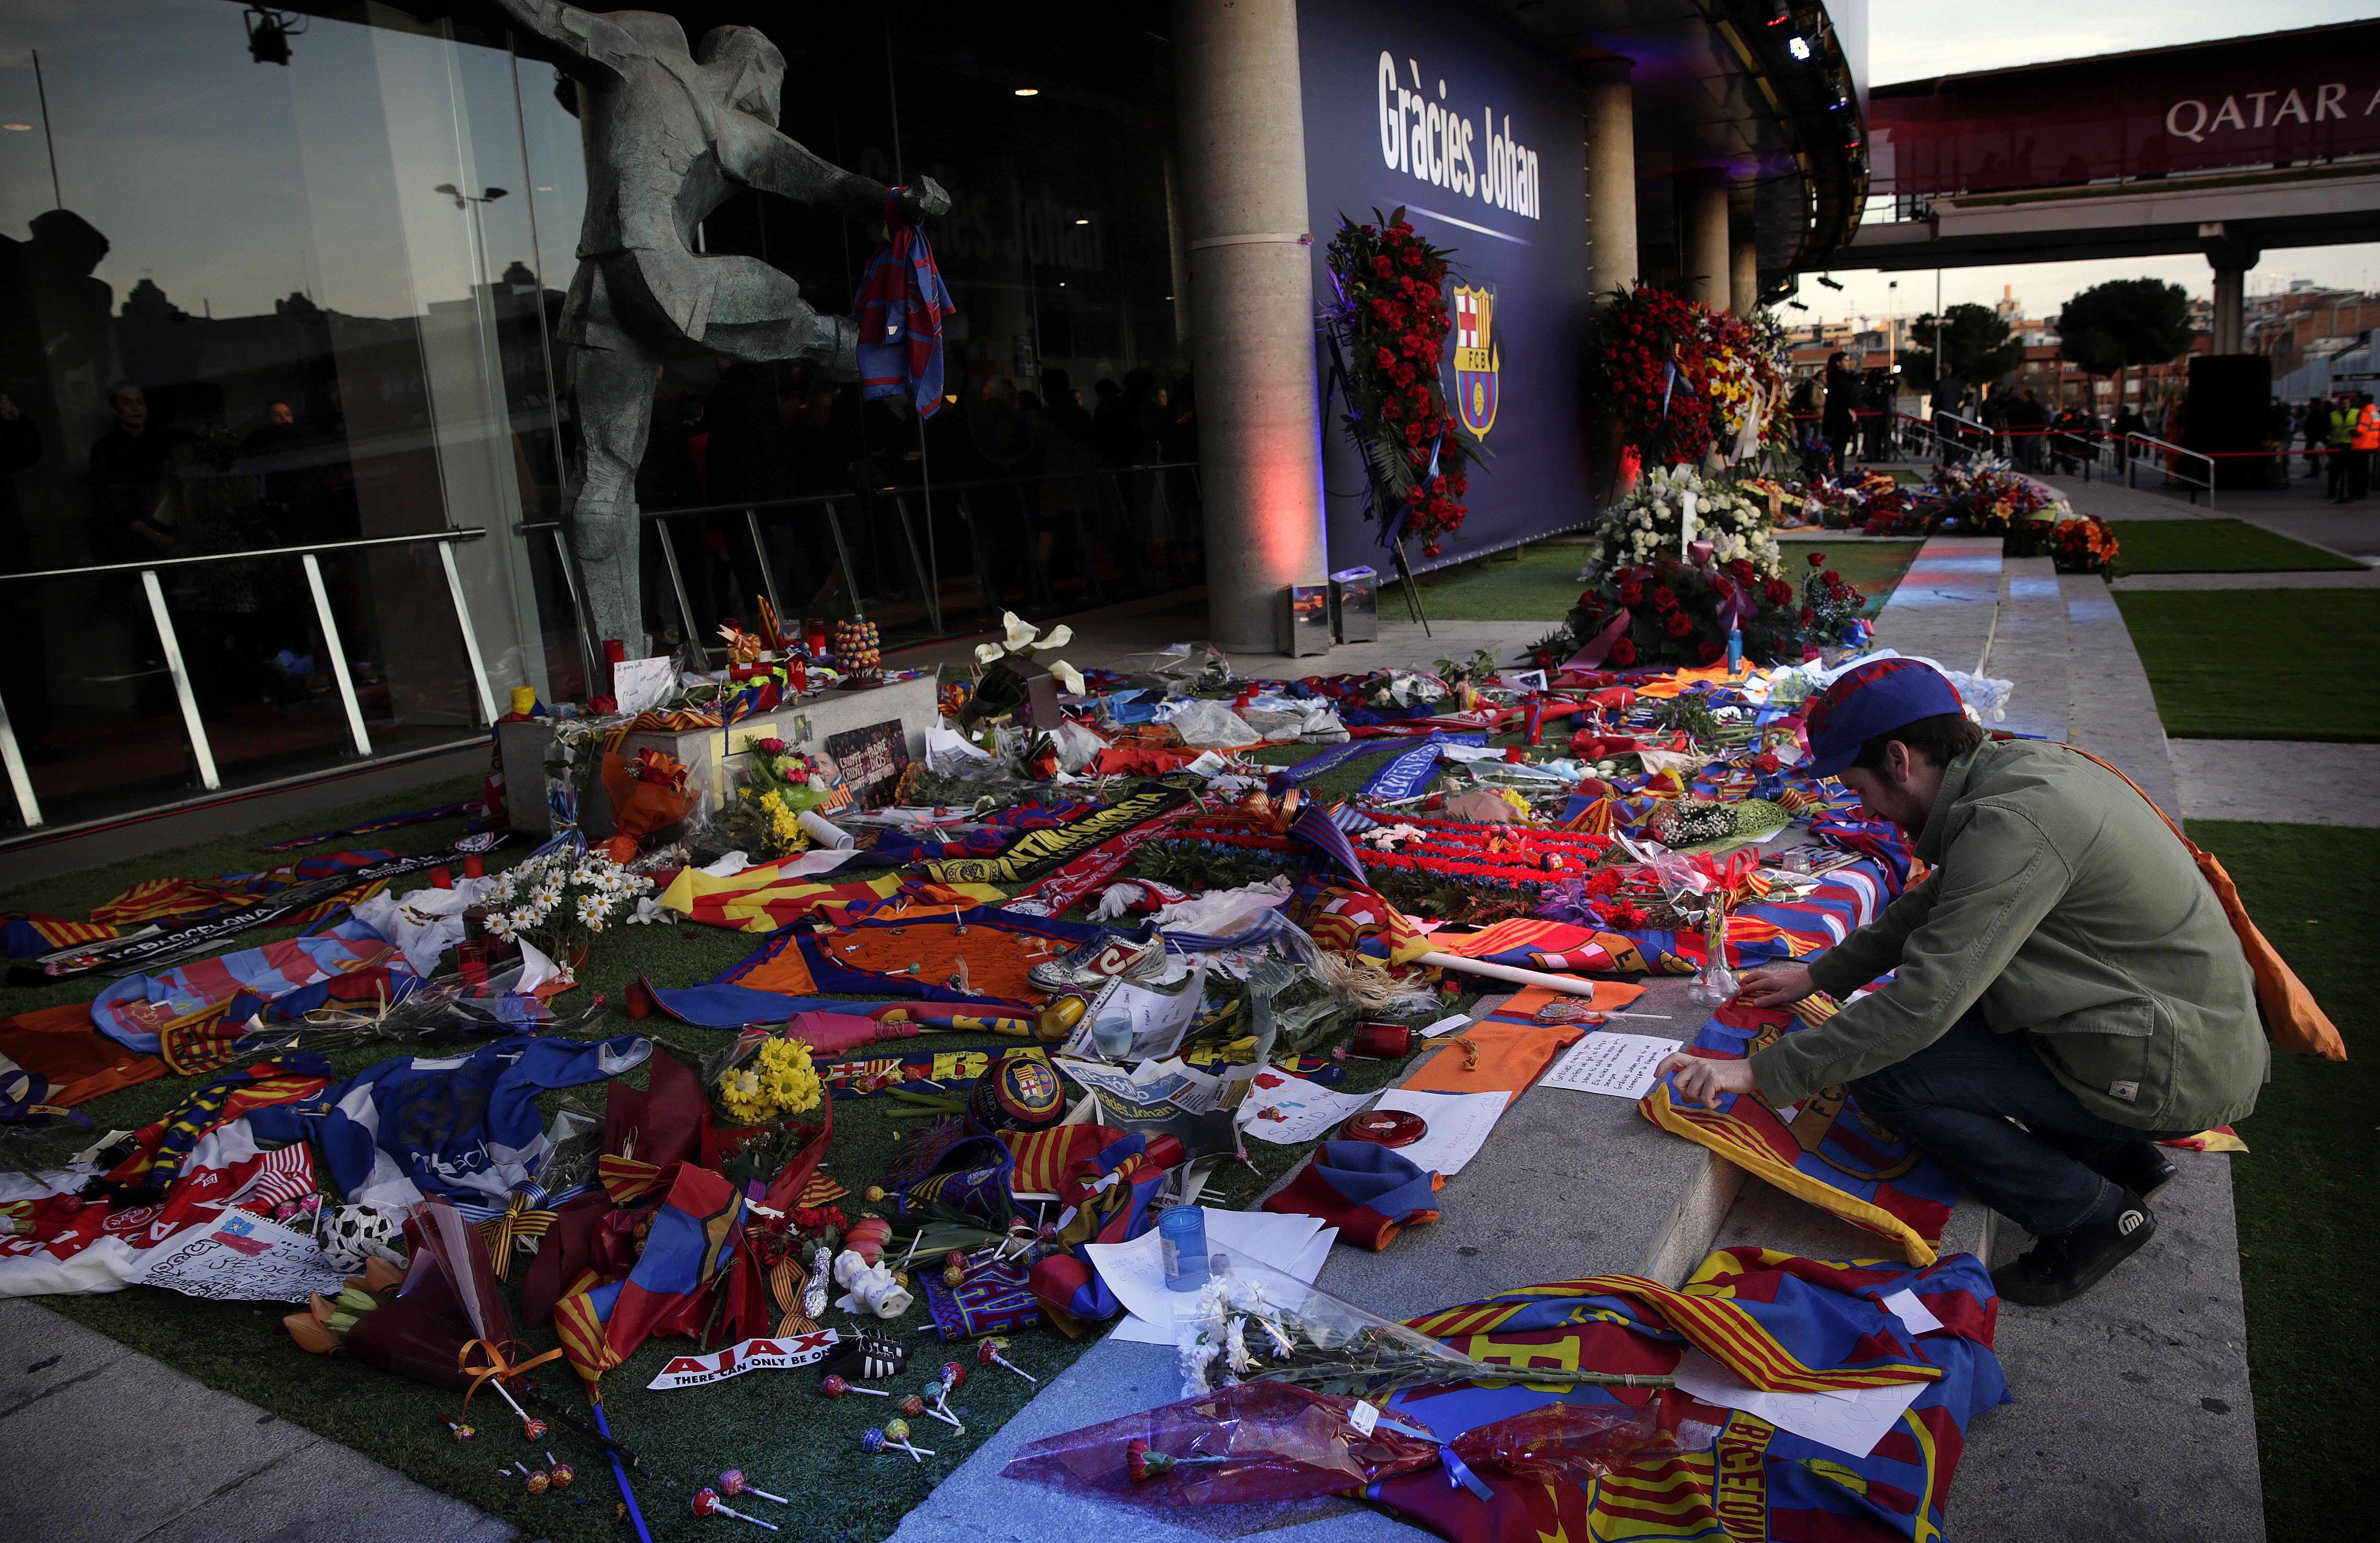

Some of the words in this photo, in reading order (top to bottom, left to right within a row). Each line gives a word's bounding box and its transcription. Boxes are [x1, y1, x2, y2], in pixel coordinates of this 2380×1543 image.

[2166, 83, 2347, 143] QATAR
[1379, 50, 1476, 198] Gràcies
[1480, 107, 1540, 220] Johan
[1469, 351, 1485, 368] FCB
[789, 661, 804, 673] 14
[866, 739, 888, 759] PADRE
[869, 753, 886, 771] DIOS
[1131, 1105, 1176, 1118] Johan
[662, 1329, 838, 1375] AJAX
[674, 1373, 715, 1385] THERE
[720, 1363, 747, 1377] CAN
[752, 1358, 785, 1367] ONLY
[791, 1355, 807, 1365] BE
[812, 1348, 831, 1360] ON
